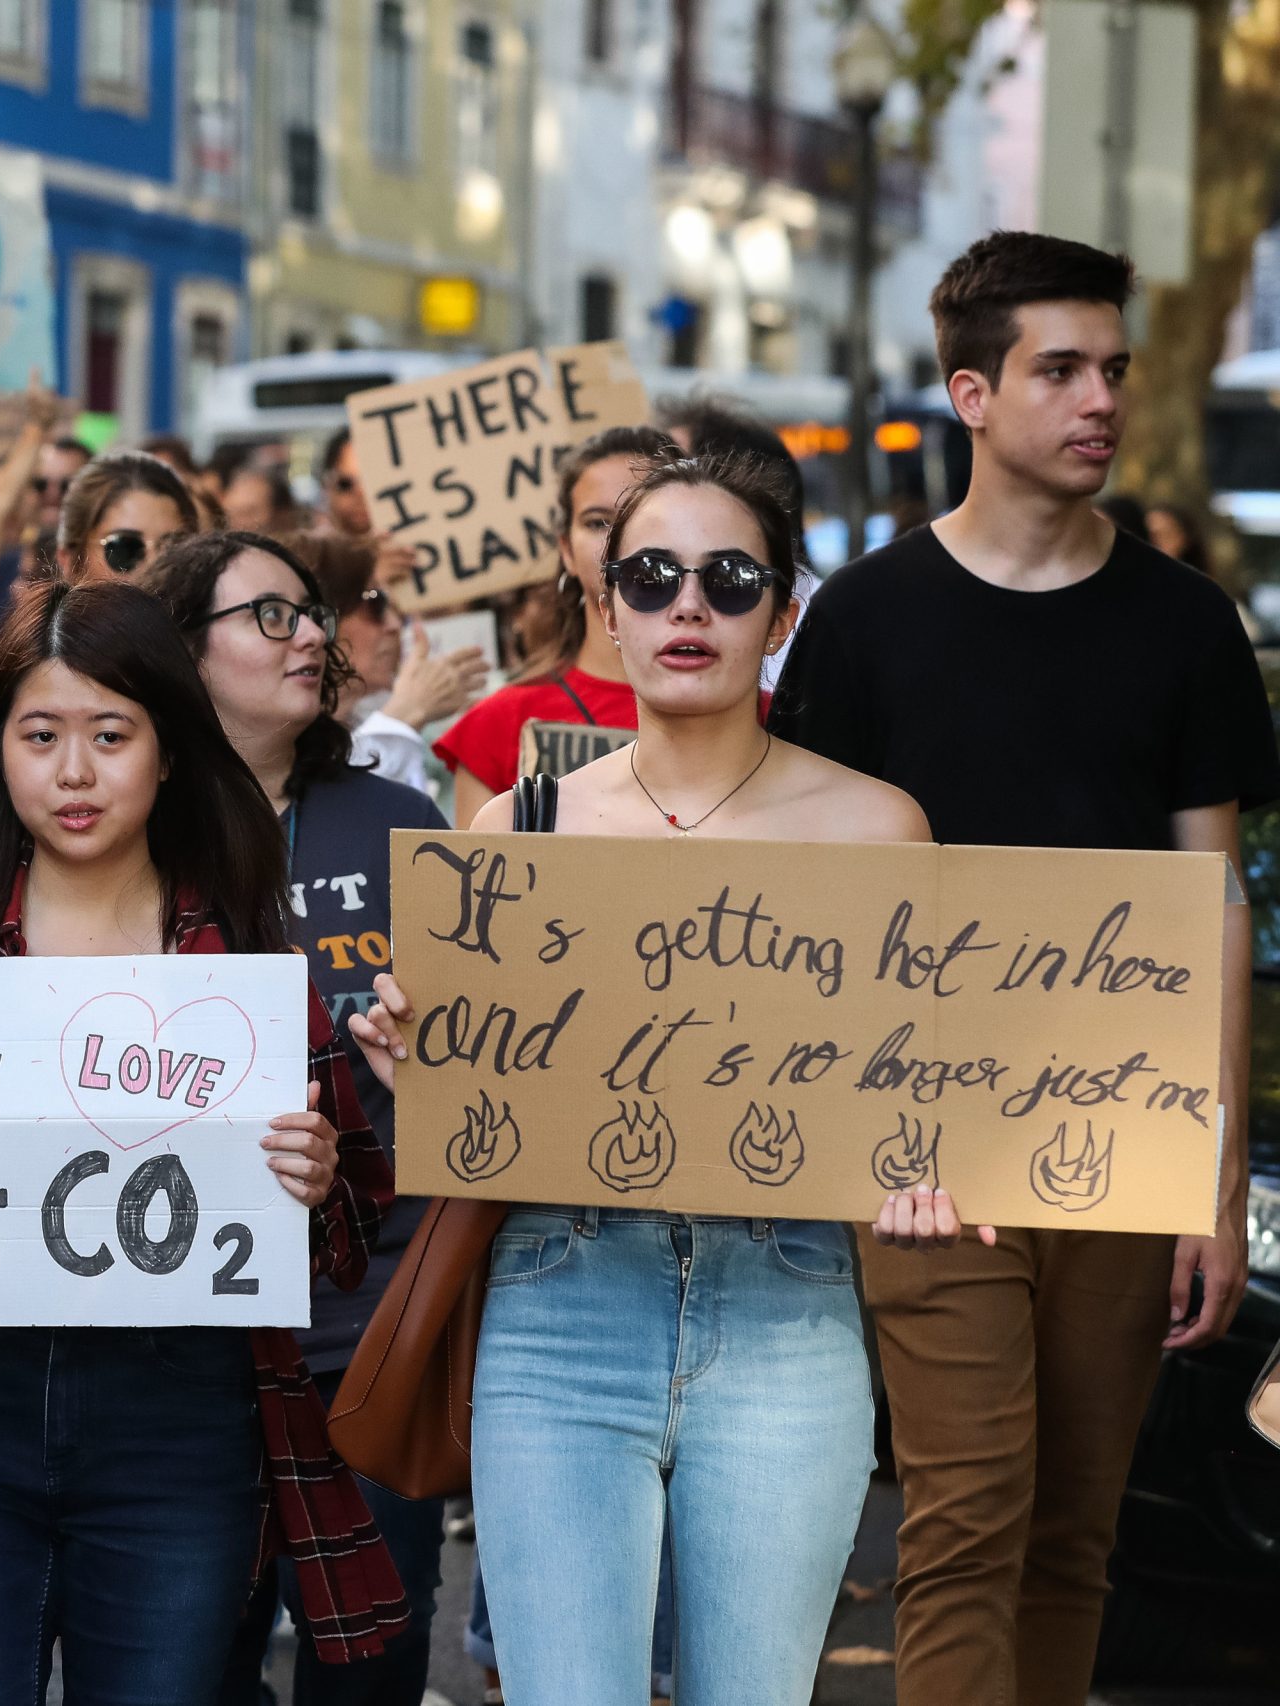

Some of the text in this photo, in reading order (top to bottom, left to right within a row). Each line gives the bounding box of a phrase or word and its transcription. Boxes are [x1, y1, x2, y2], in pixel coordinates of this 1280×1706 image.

[362, 360, 598, 467] THERE
[375, 467, 477, 533] IS
[317, 931, 391, 970] TO
[413, 841, 1193, 997] It's getting hot in here
[78, 1033, 226, 1109] LOVE
[600, 1002, 755, 1095] it's
[768, 1038, 853, 1086] no
[1001, 1052, 1167, 1116] just
[1144, 1078, 1212, 1127] me
